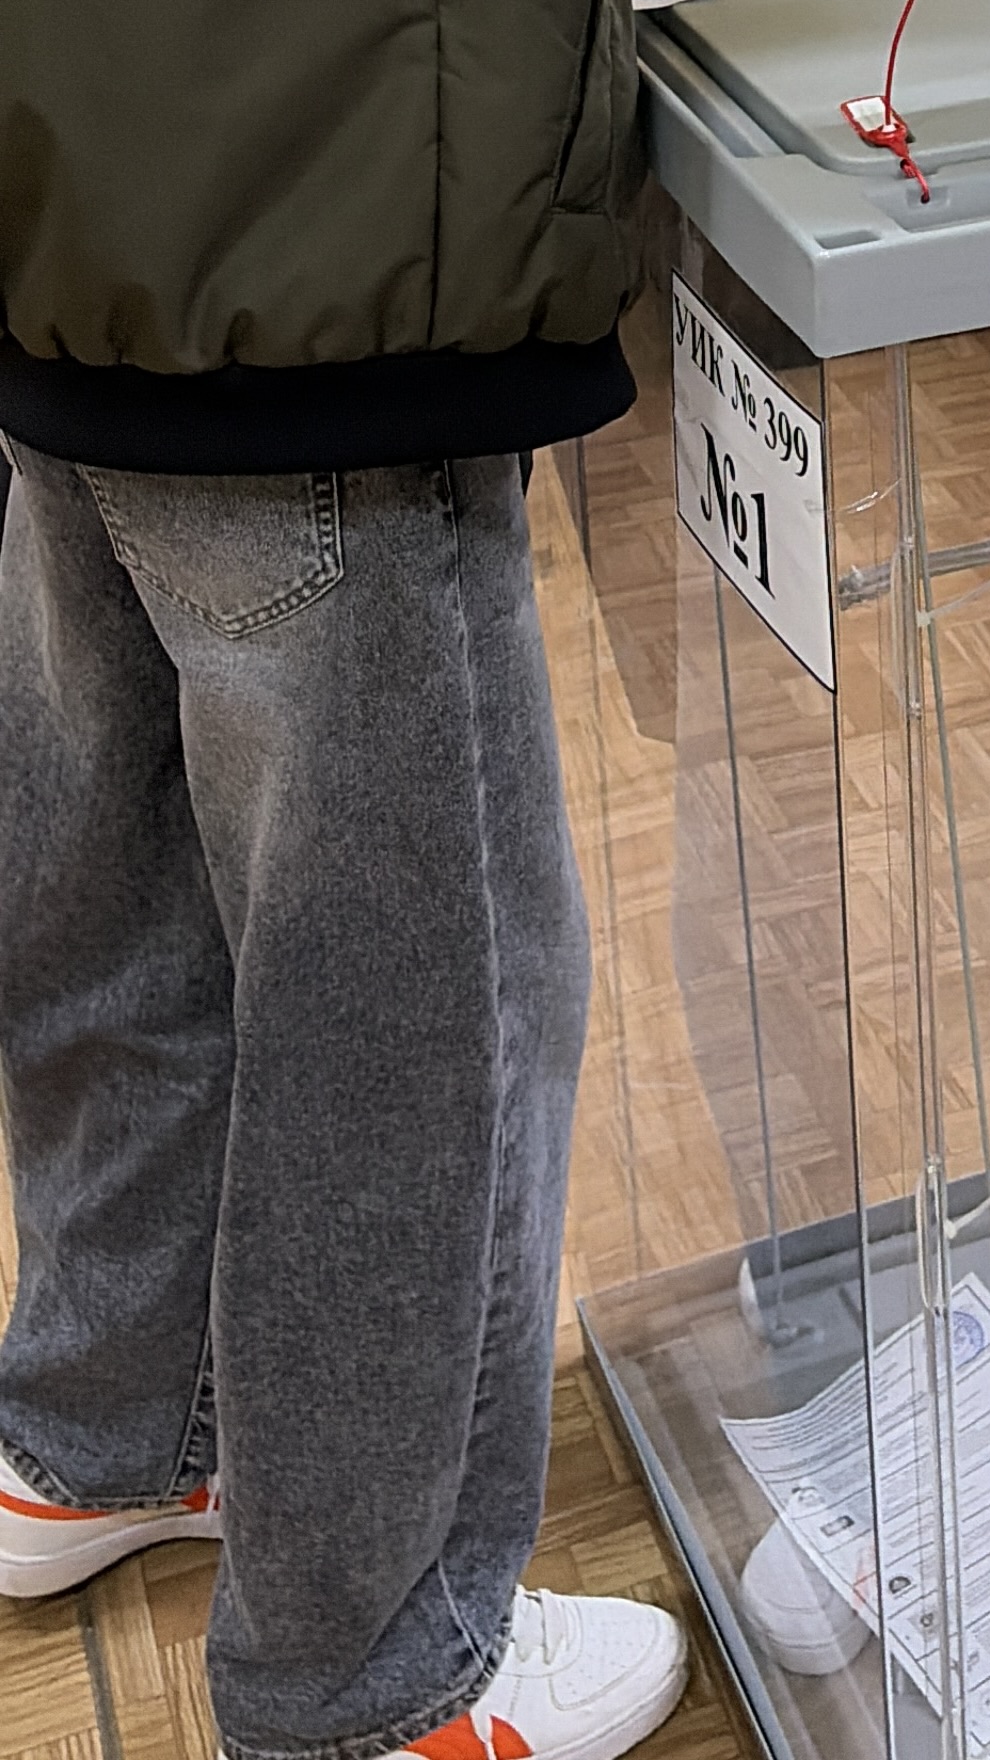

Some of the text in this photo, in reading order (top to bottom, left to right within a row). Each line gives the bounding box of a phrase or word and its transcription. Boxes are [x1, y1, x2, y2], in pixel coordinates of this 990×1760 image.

[674, 293, 809, 477] УИК № 399
